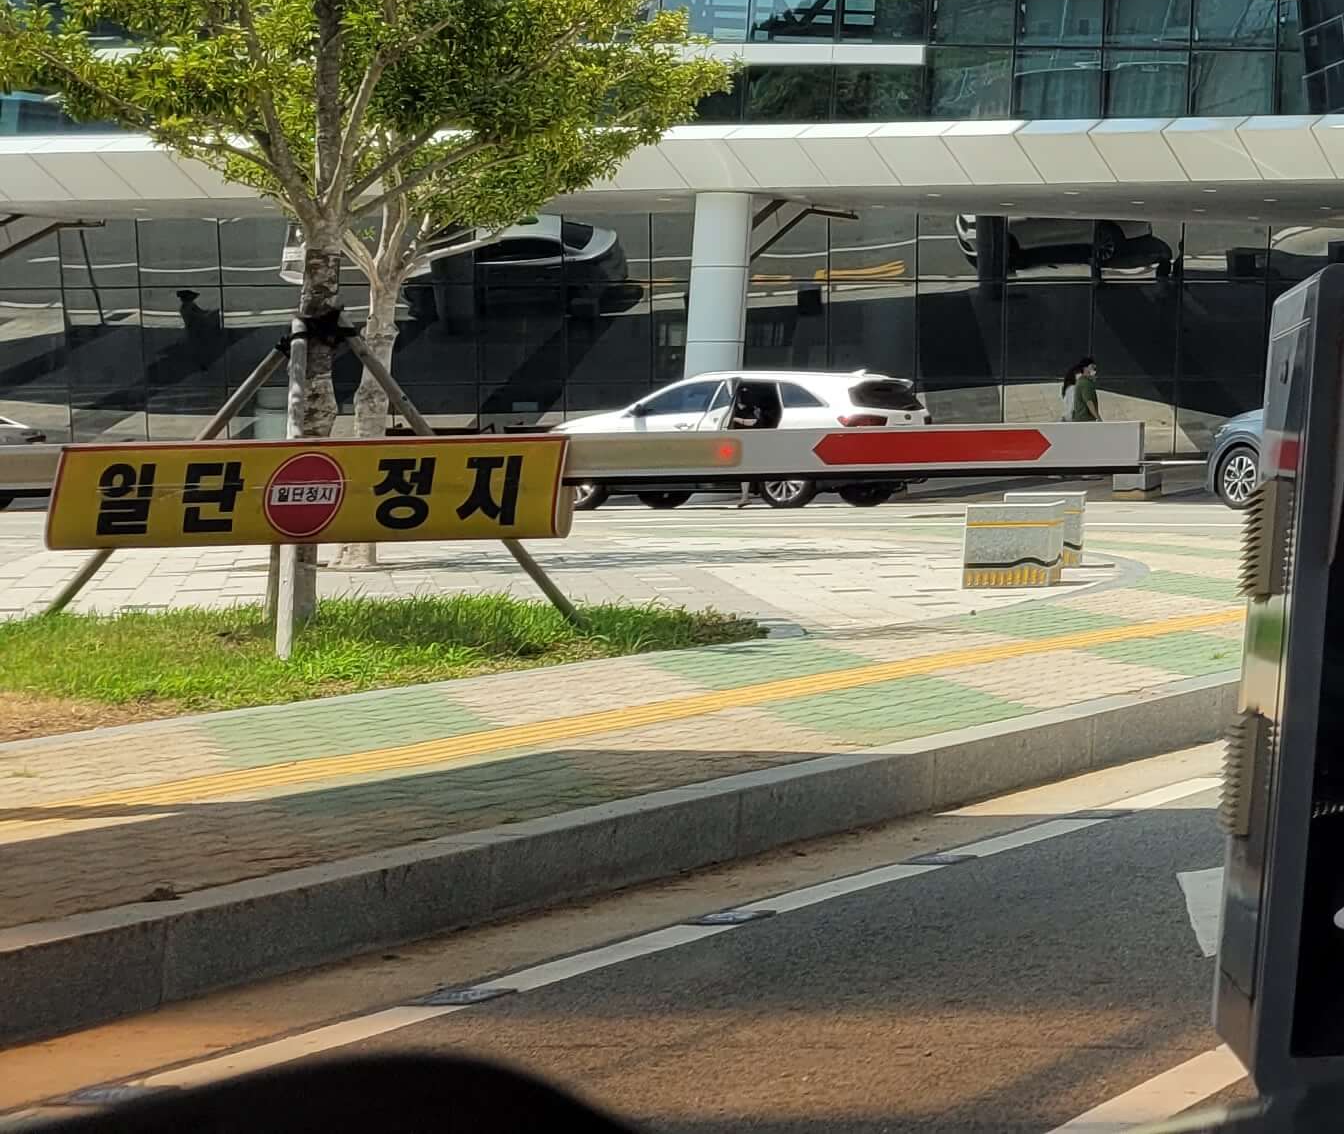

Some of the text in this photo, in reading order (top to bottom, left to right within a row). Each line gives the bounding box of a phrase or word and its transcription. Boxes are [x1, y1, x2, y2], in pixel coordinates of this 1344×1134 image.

[96, 456, 524, 534] 일단 정지
[278, 487, 333, 502] 일단정지
